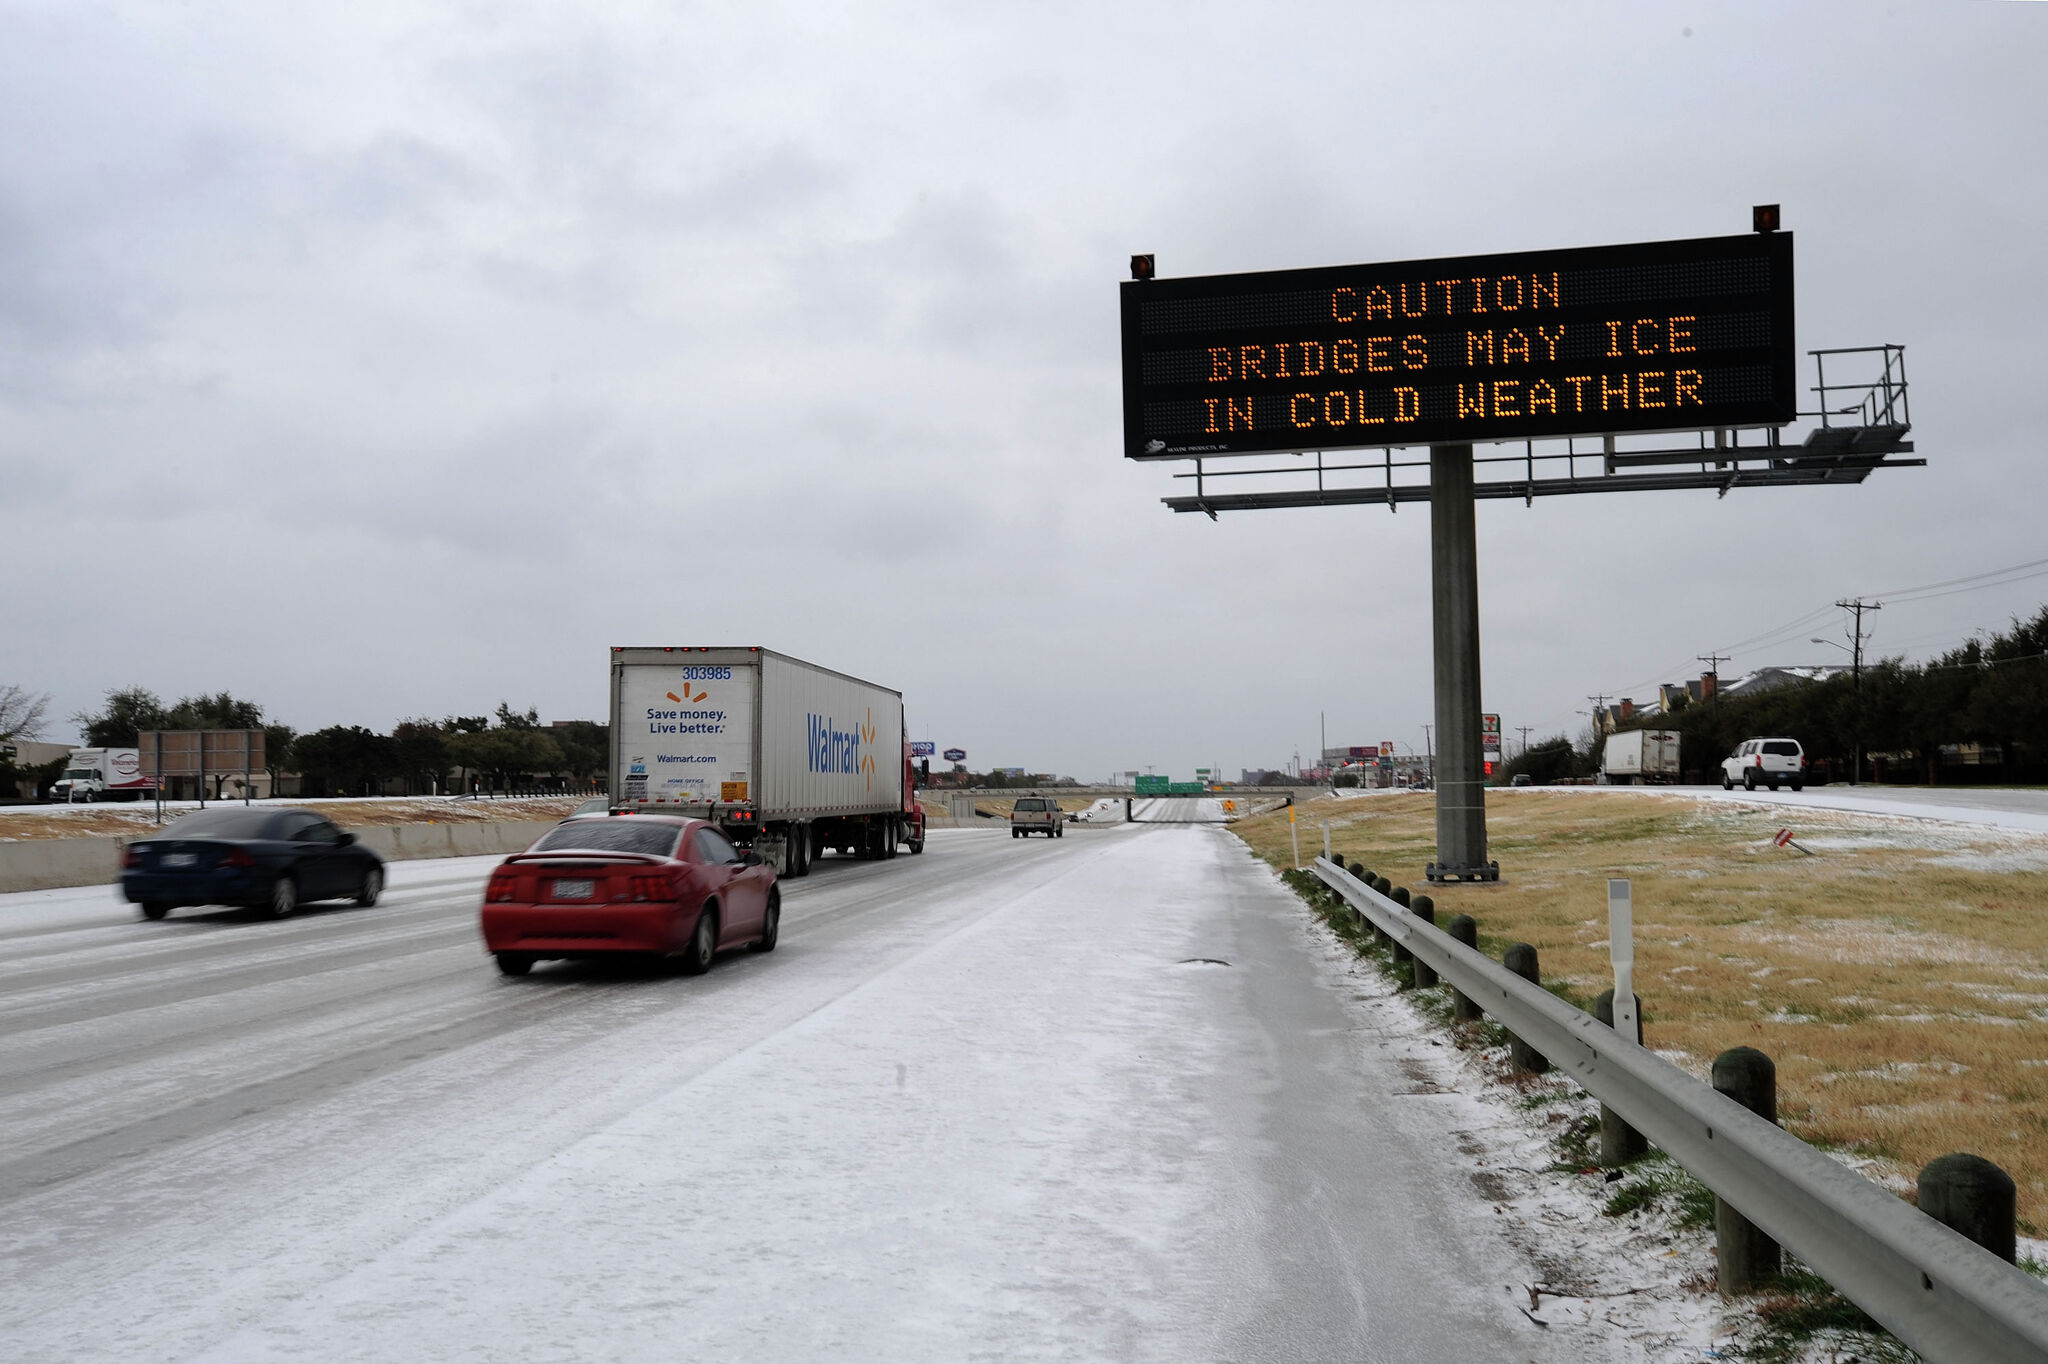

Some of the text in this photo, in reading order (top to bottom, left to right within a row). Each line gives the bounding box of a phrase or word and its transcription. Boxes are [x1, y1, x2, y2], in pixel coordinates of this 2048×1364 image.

[1331, 271, 1561, 325] CAUTION
[1206, 314, 1698, 384] BRIDGES MAY ICE
[1203, 367, 1705, 434] IN COLD WEATHER
[682, 666, 732, 680] 303985
[647, 709, 727, 722] Save money.
[650, 723, 677, 734] Live
[657, 754, 717, 763] Walmart.com
[807, 712, 860, 775] Walmart
